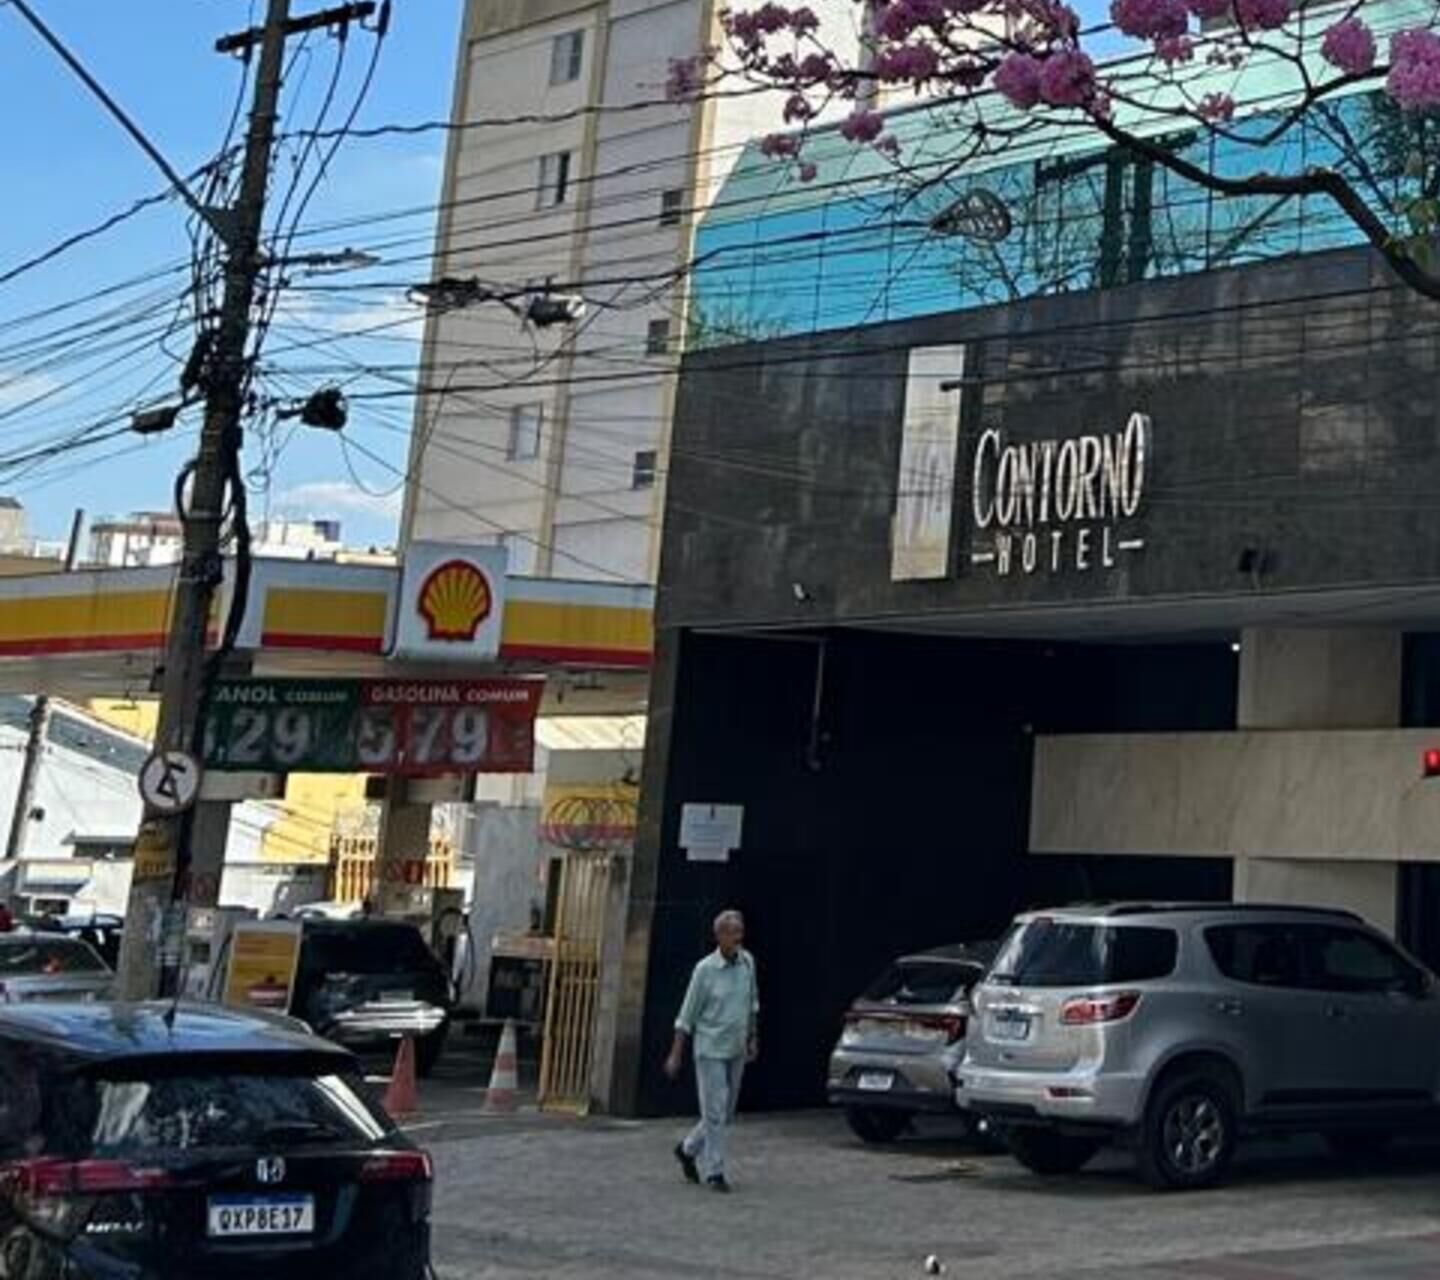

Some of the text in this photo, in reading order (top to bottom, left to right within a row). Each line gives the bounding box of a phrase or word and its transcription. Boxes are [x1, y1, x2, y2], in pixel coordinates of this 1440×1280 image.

[973, 412, 1147, 528] CONTORNO
[997, 527, 1113, 575] HOTEL
[214, 684, 277, 703] ANOL
[371, 684, 460, 704] GASOLINA
